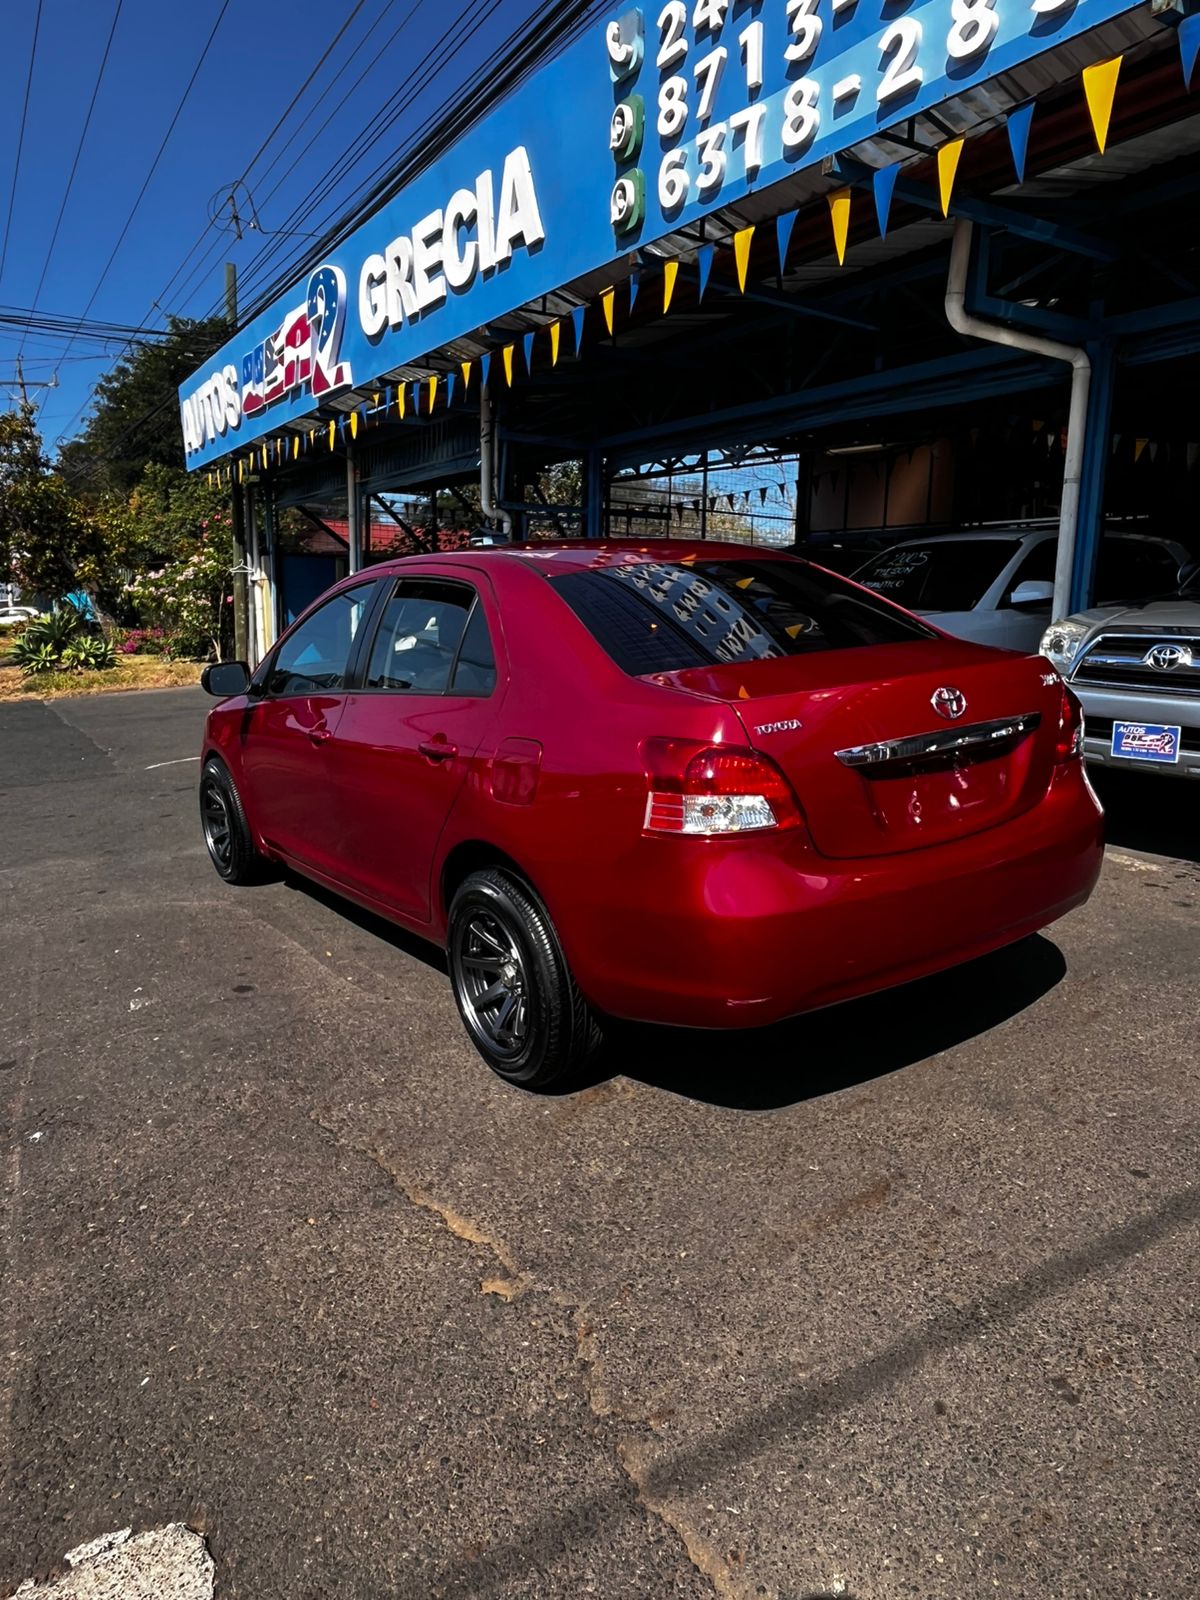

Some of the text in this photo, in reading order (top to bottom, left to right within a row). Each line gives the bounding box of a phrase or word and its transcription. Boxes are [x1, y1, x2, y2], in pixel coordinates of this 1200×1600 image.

[657, 0, 1075, 209] 6378-28
[181, 364, 241, 452] AUTOS
[358, 145, 545, 337] GRECIA
[753, 719, 802, 736] TOYOTA
[1117, 725, 1147, 734] AUTOS
